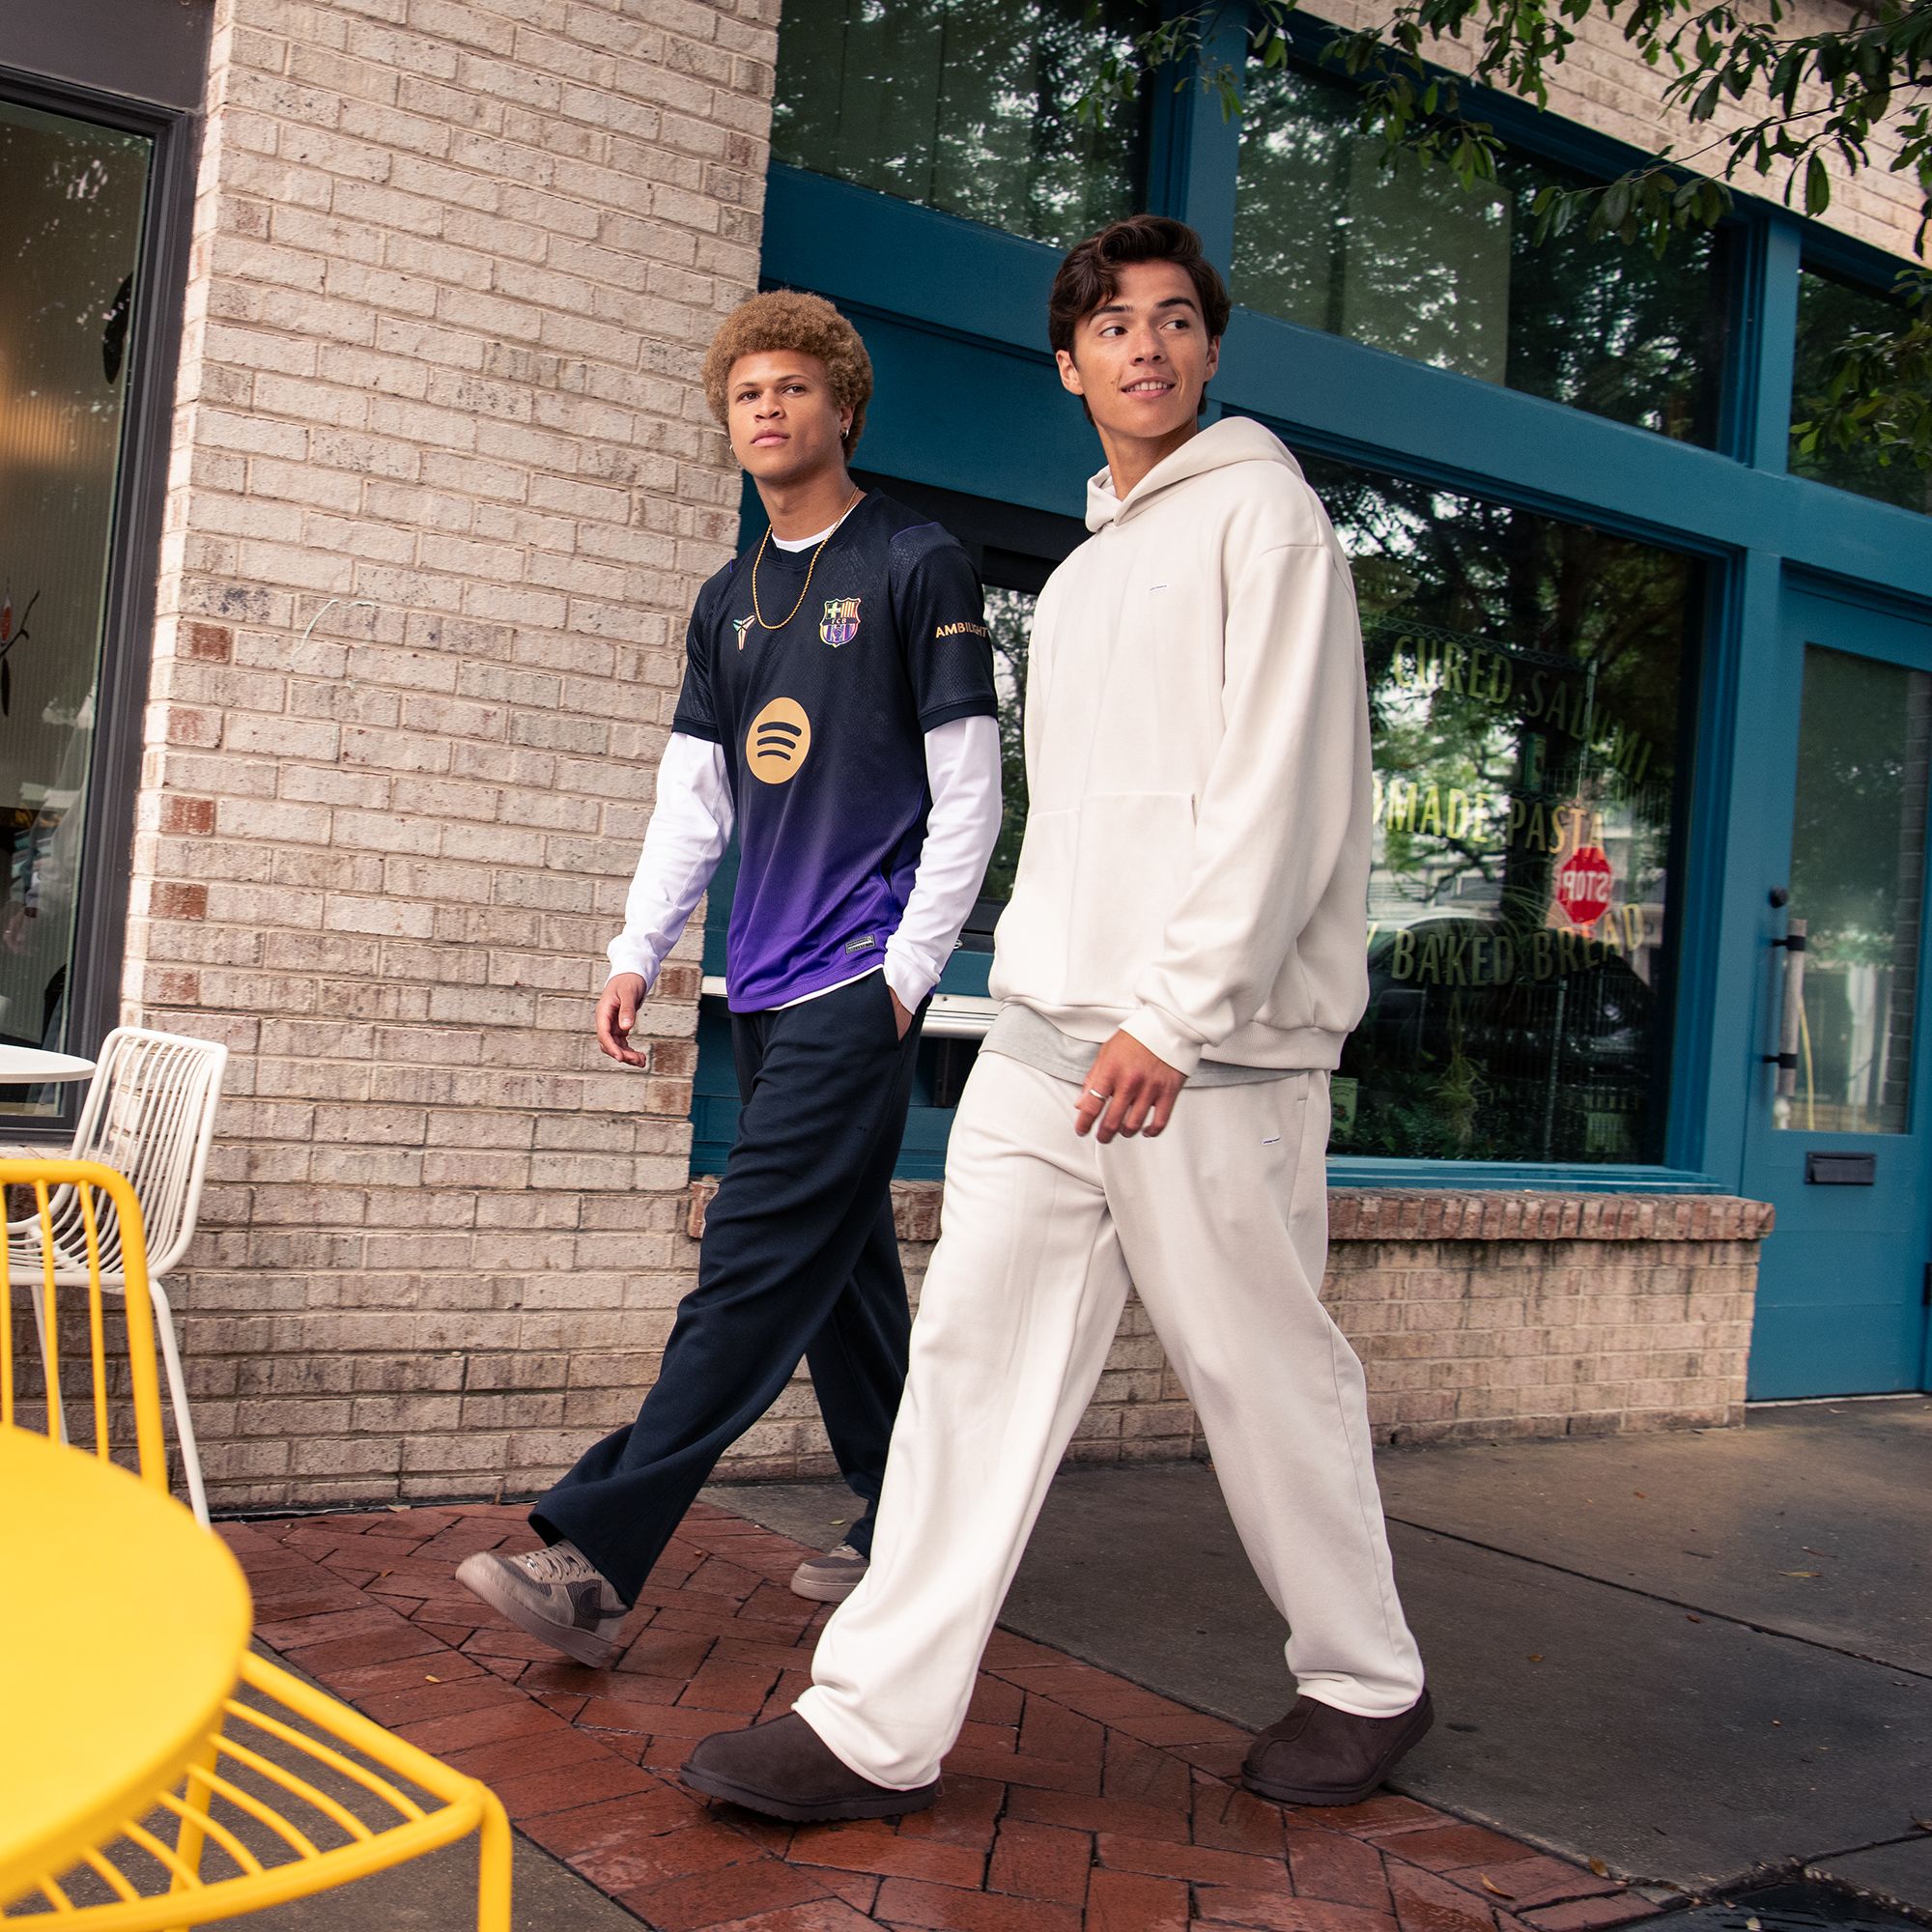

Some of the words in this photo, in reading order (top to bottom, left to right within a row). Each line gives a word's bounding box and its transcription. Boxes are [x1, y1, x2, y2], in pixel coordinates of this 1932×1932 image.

[1392, 635, 1514, 704] CURED
[1526, 669, 1654, 784] SALUMI
[1505, 798, 1606, 859] PASTA
[1391, 927, 1516, 987] BAKED
[1533, 903, 1645, 982] BREAD
